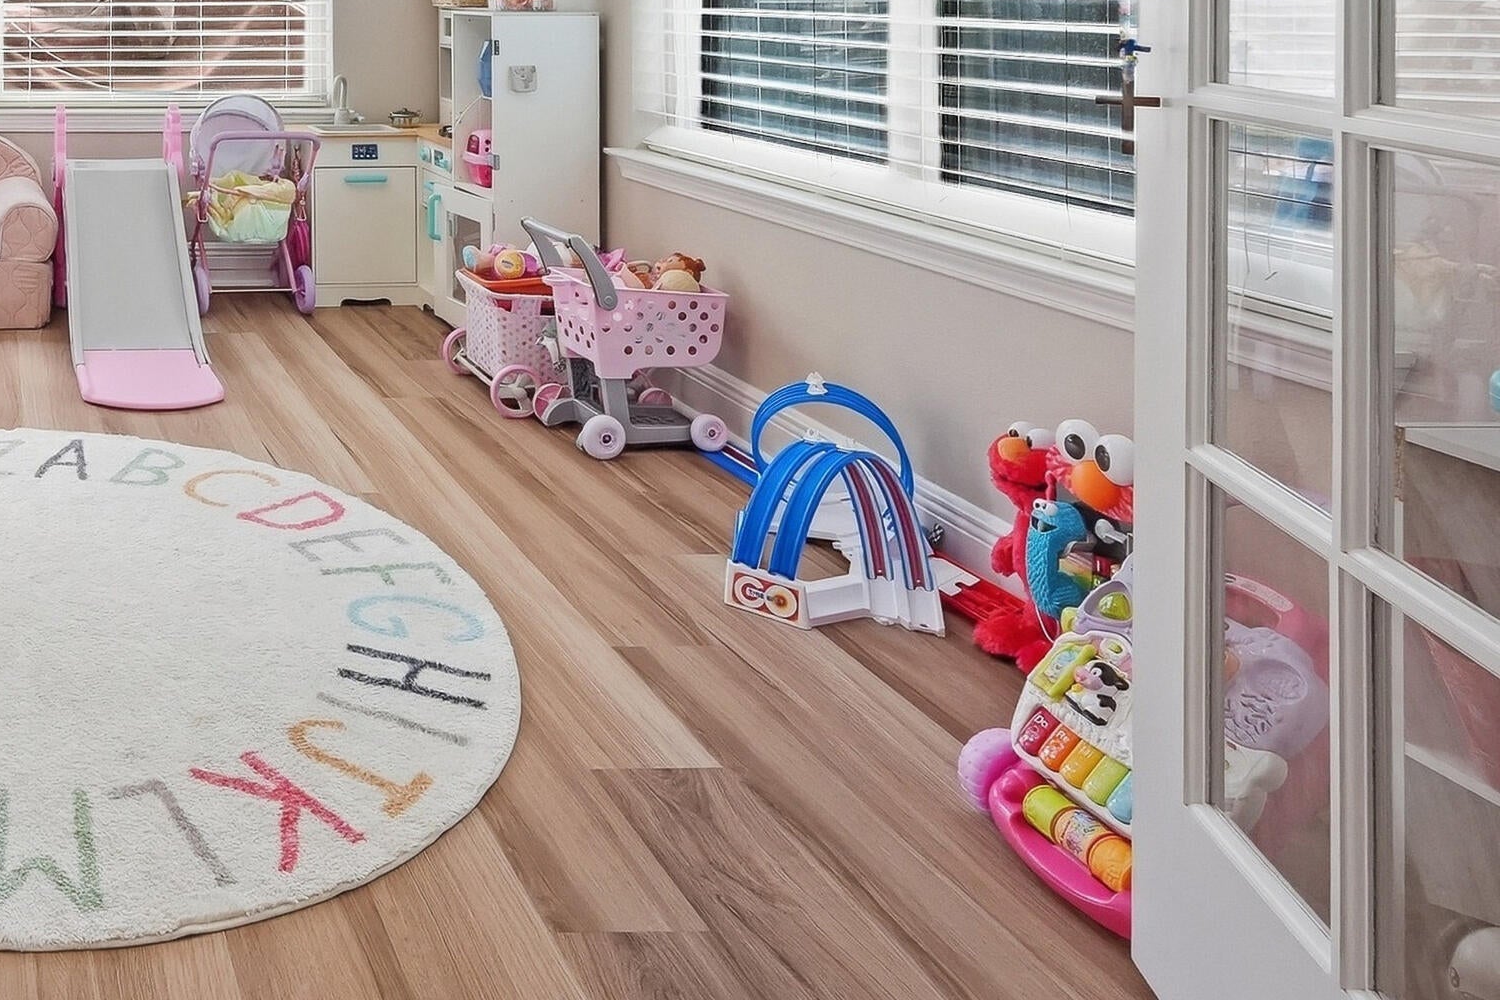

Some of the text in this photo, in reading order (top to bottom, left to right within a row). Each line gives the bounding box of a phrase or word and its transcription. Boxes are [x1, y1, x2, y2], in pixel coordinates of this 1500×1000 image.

[33, 437, 89, 483] A
[109, 447, 187, 488] B
[182, 468, 280, 508] C
[235, 489, 348, 532] D
[288, 526, 412, 565] E
[320, 559, 455, 599] F
[345, 594, 491, 643] G
[337, 642, 493, 711] H
[315, 692, 469, 748] I
[1034, 713, 1048, 727] Do
[286, 718, 434, 818] J
[106, 776, 238, 888] L
[187, 749, 368, 873] K
